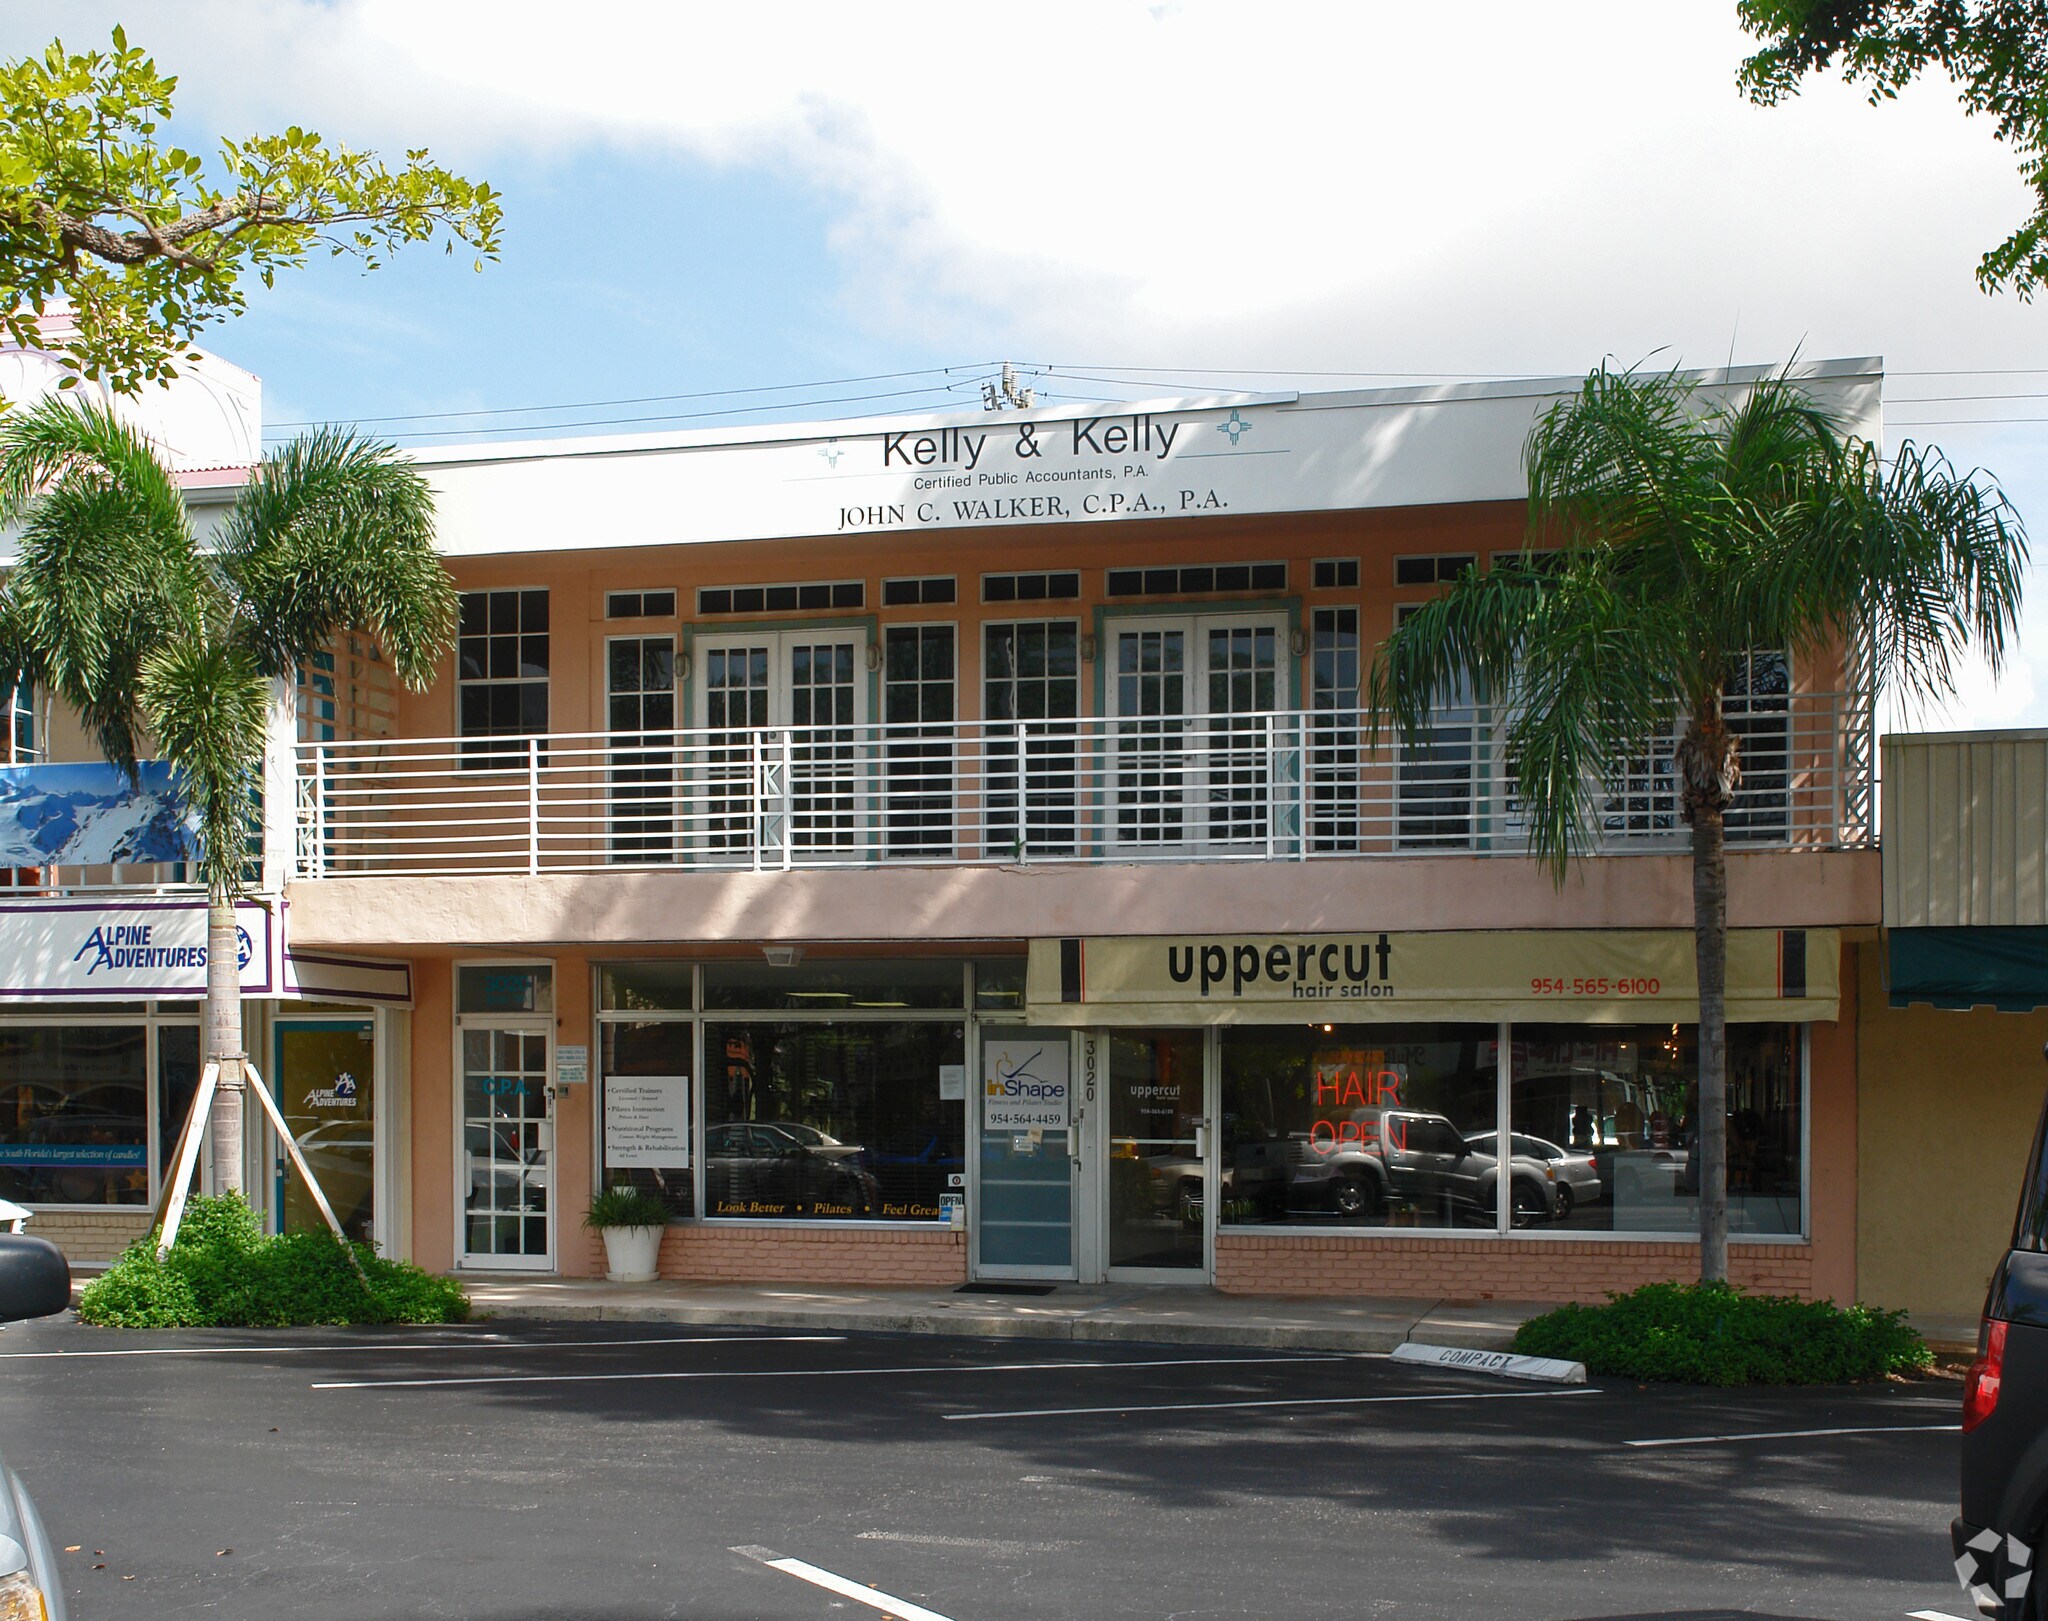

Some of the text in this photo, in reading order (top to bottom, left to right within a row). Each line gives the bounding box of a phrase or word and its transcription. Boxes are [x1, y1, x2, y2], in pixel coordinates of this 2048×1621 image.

[884, 415, 1180, 470] Kelly & Kelly
[914, 466, 1149, 490] Certified Public Accountants, P.A.
[838, 489, 1229, 531] JOHN C. WALKER, C.P.A., P.A.
[73, 926, 152, 961] ALPINE
[87, 946, 207, 975] ADVENTURES
[1168, 934, 1391, 996] uppercut
[1292, 981, 1394, 998] hair salon
[1531, 978, 1660, 995] 954-565-6100
[1086, 1041, 1095, 1101] 3020
[303, 1089, 335, 1103] ALPINE
[482, 1079, 530, 1095] C.P.A.
[987, 1079, 1065, 1100] inShape
[1130, 1085, 1180, 1098] uppercut
[1317, 1071, 1400, 1106] HAIR
[308, 1097, 357, 1109] ADVENTURES
[1310, 1120, 1407, 1156] OPEN
[717, 1200, 785, 1213] Look Better
[813, 1203, 852, 1214] Pilates
[882, 1203, 940, 1216] Feel Grea
[1439, 1350, 1513, 1368] COMPACT
